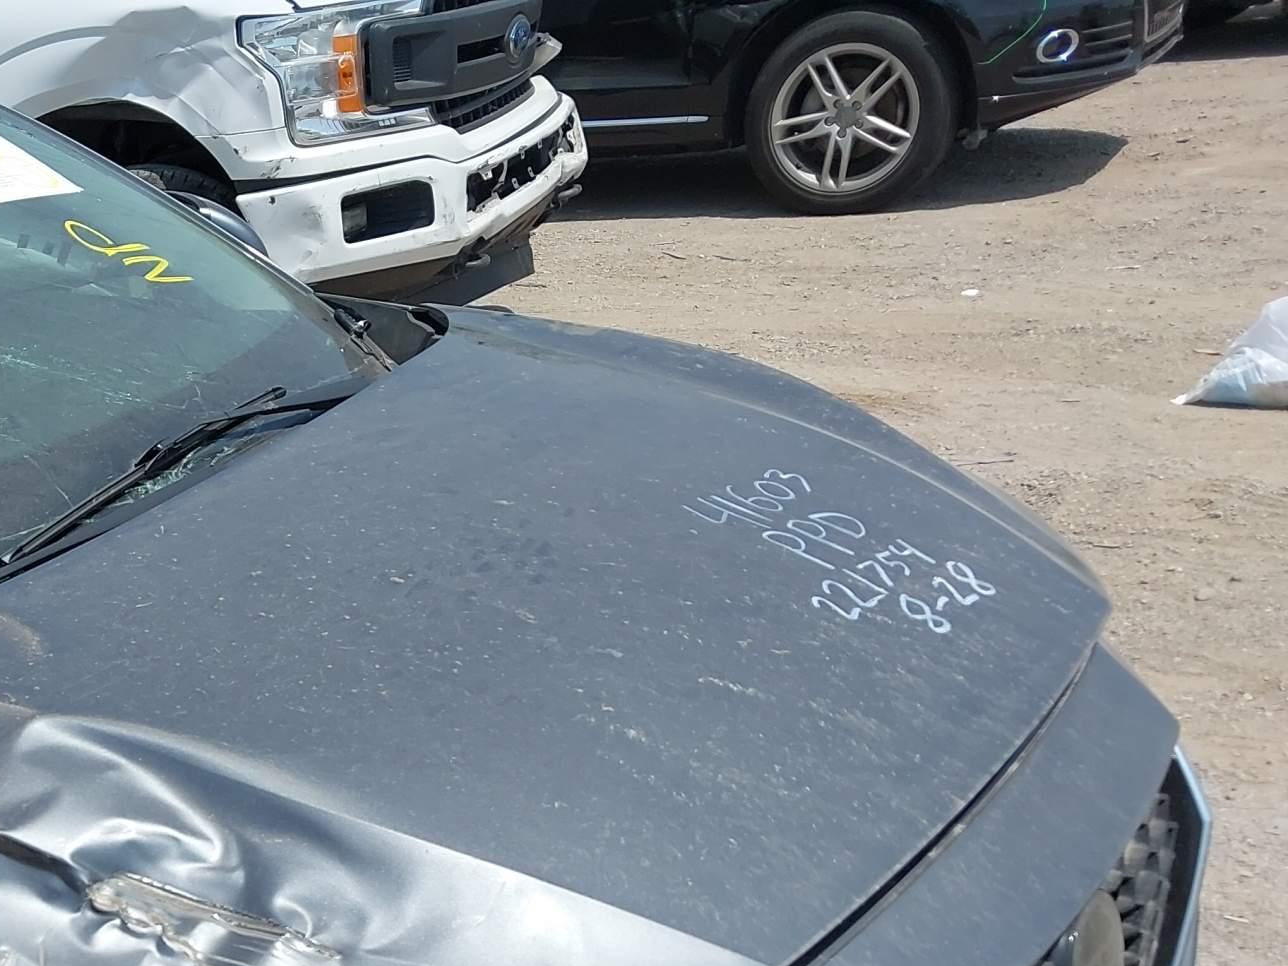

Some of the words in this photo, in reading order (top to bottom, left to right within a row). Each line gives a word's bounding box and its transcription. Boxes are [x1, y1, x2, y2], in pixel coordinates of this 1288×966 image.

[681, 468, 812, 529] 41603
[761, 511, 866, 570] PPD
[811, 538, 937, 621] 221754
[899, 560, 998, 634] 8-28
